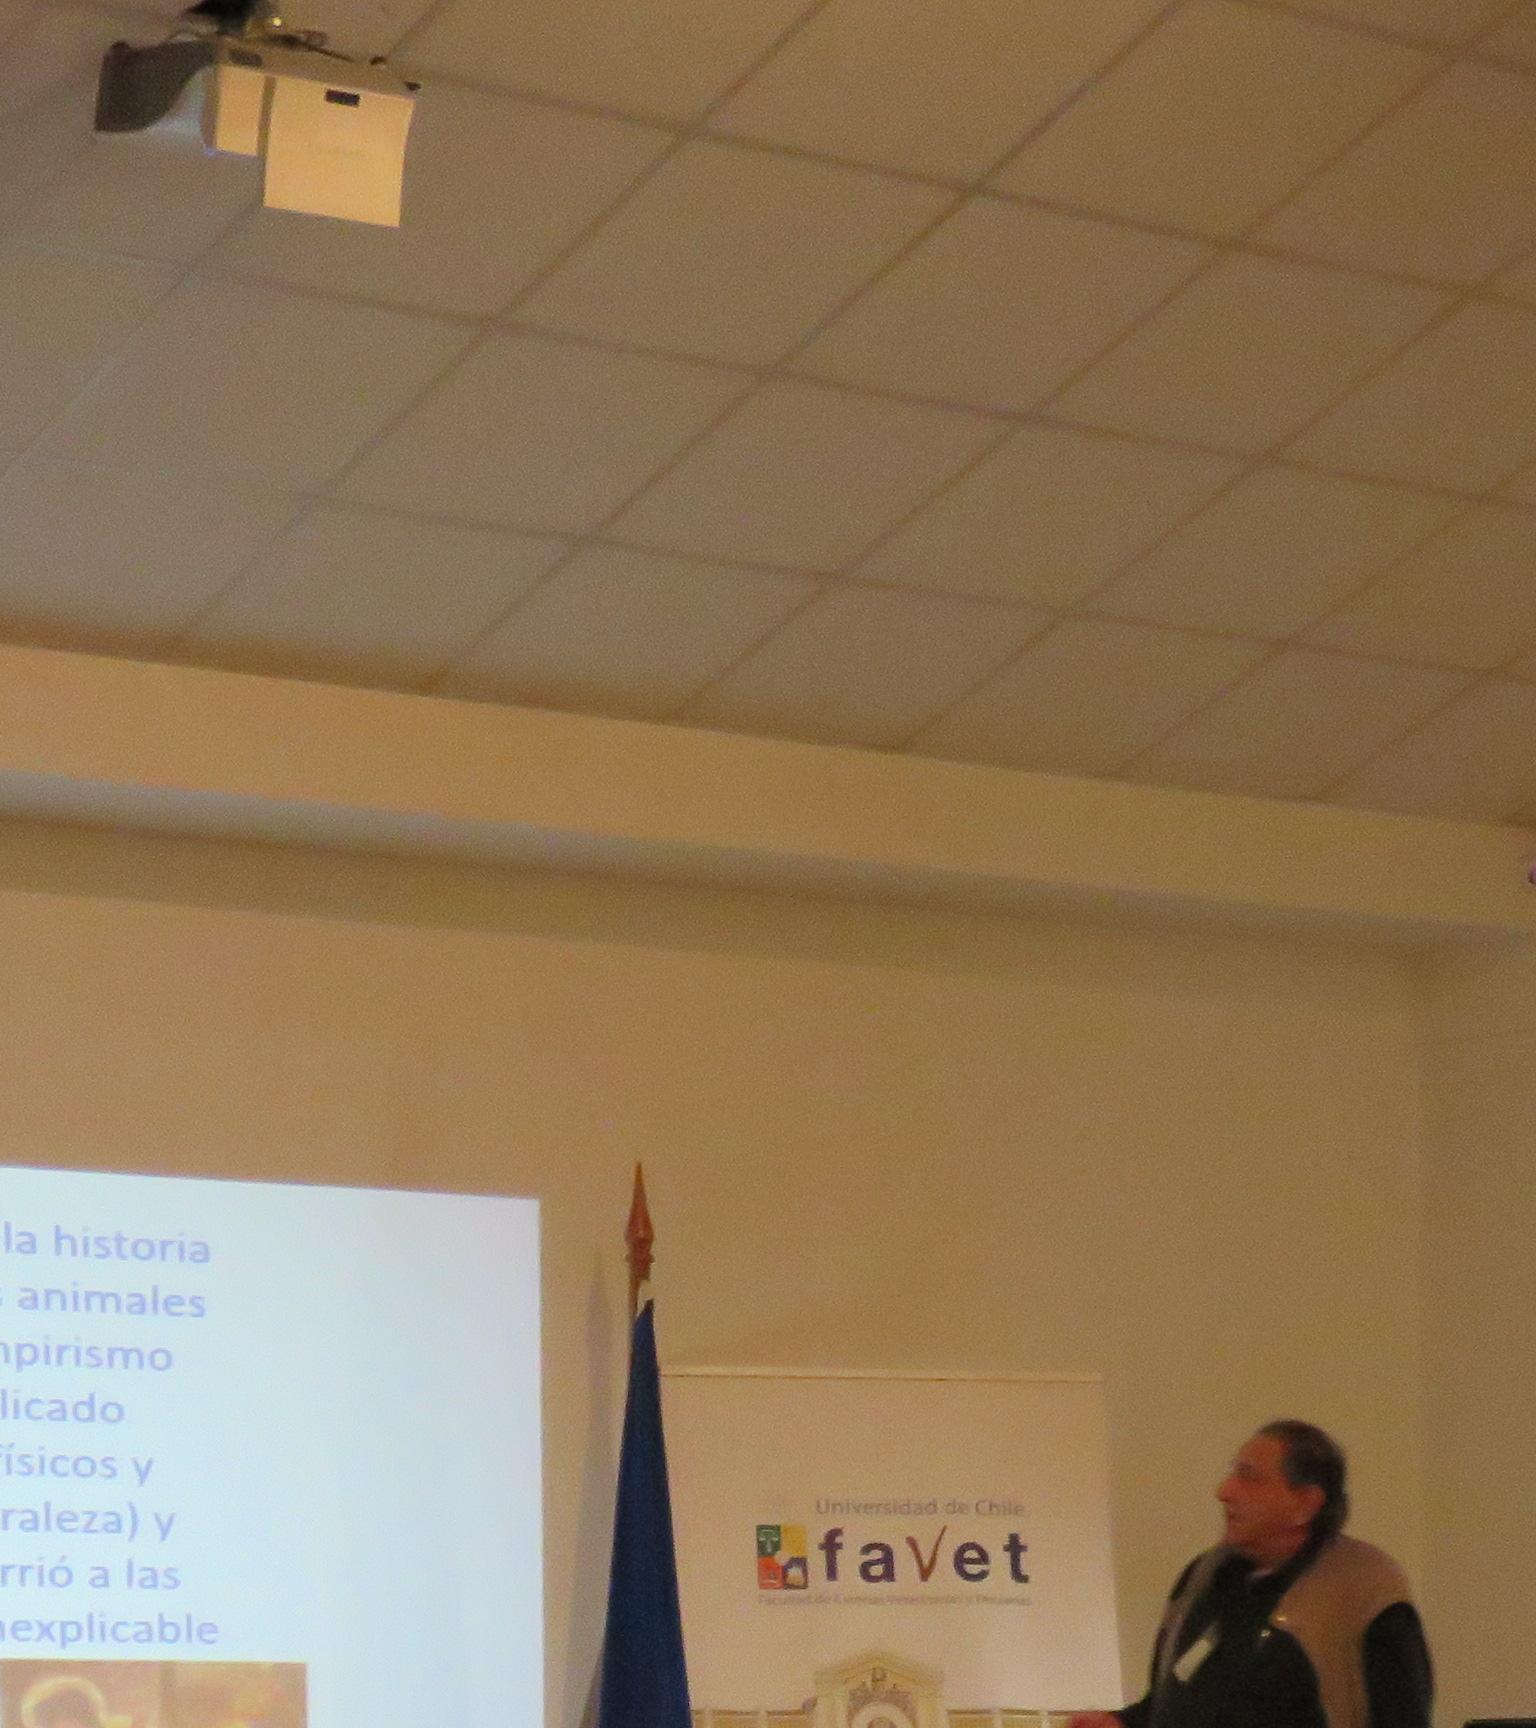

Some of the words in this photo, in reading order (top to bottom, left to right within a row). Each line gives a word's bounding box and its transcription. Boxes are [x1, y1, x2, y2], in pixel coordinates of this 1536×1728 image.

[3, 1221, 39, 1255] la
[52, 1224, 212, 1264] historia
[17, 1285, 207, 1318] animales
[132, 1458, 155, 1486] y
[815, 1498, 937, 1516] Universidad
[943, 1499, 969, 1516] de
[974, 1500, 1026, 1518] Chile
[153, 1513, 176, 1542] y
[88, 1566, 112, 1589] a
[125, 1558, 181, 1590] las
